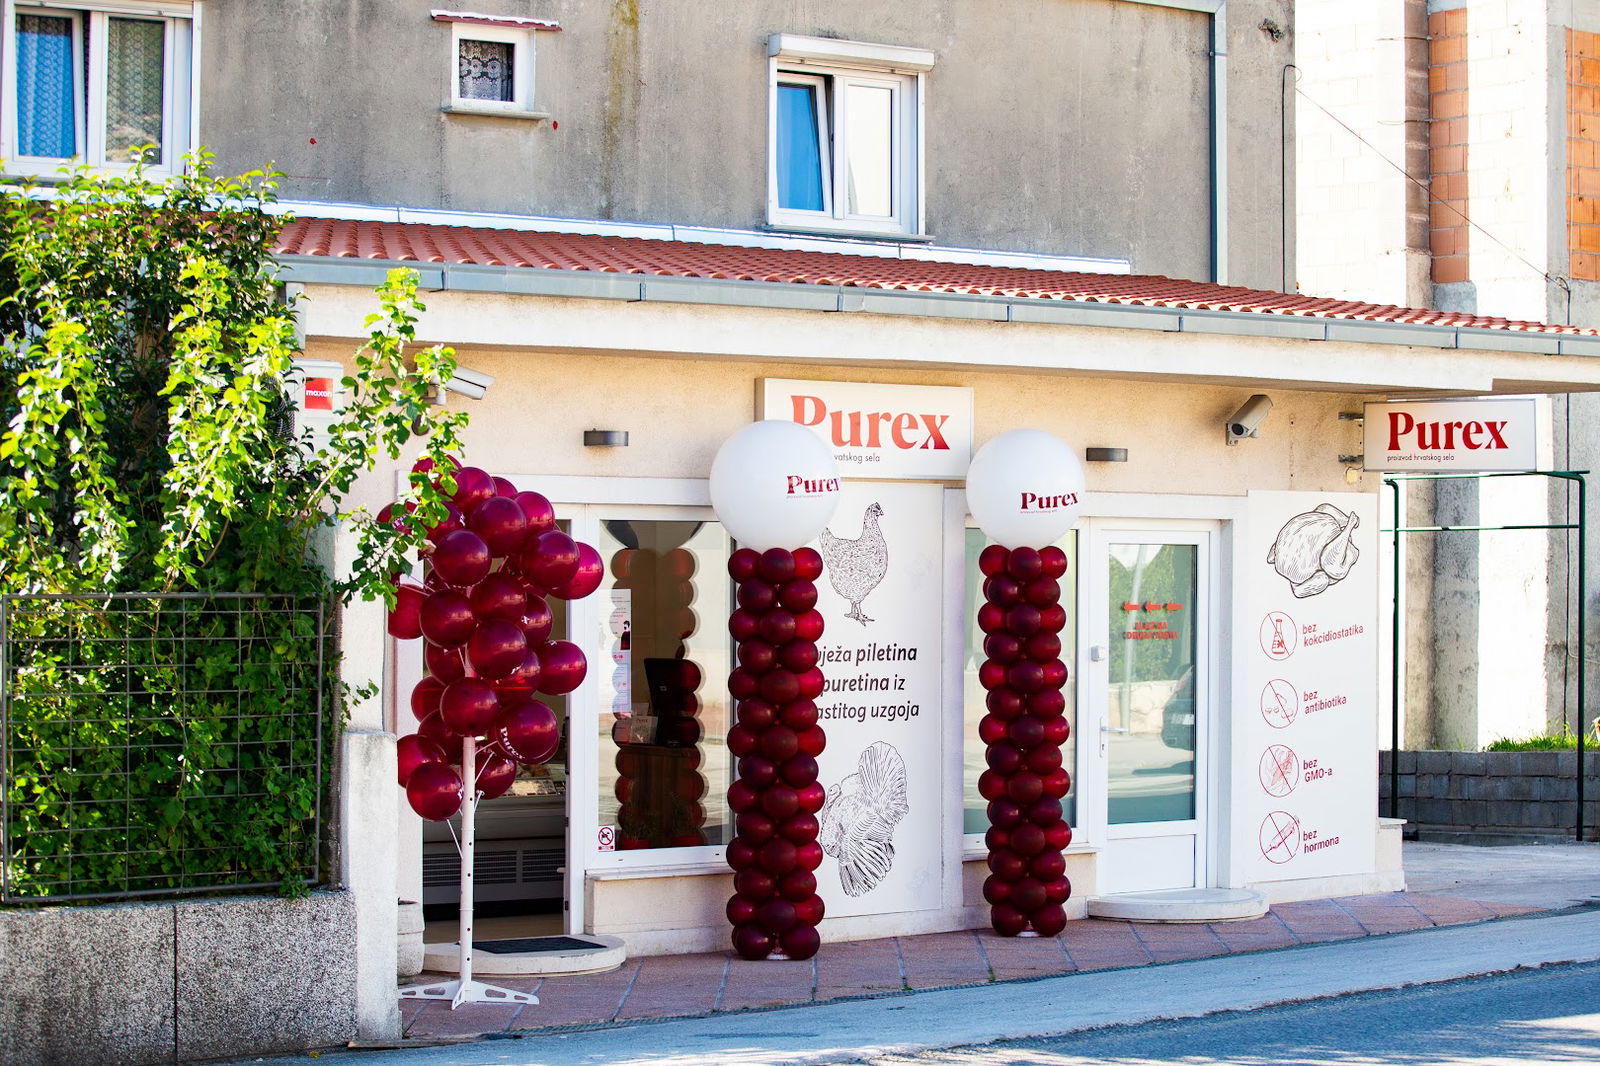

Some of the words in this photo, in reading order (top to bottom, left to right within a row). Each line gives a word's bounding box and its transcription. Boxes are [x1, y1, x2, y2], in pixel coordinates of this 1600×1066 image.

[305, 390, 332, 398] maxon
[790, 395, 951, 450] Purex
[1387, 411, 1509, 451] Purex
[833, 452, 863, 465] vatskog
[864, 452, 881, 463] sela
[1442, 453, 1455, 462] sela
[1020, 491, 1079, 510] Purex
[1302, 623, 1318, 635] bez
[1303, 624, 1364, 648] kokcidiostatika
[856, 642, 918, 667] piletina
[893, 673, 906, 691] iz
[1302, 690, 1319, 702] bez
[1303, 695, 1347, 715] antibiotika
[817, 702, 867, 723] astitog
[870, 700, 920, 722] uzgoja
[1302, 759, 1318, 770] bez
[1303, 767, 1334, 783] GMO-a
[1302, 829, 1318, 841] bez
[1303, 835, 1340, 855] hormona
